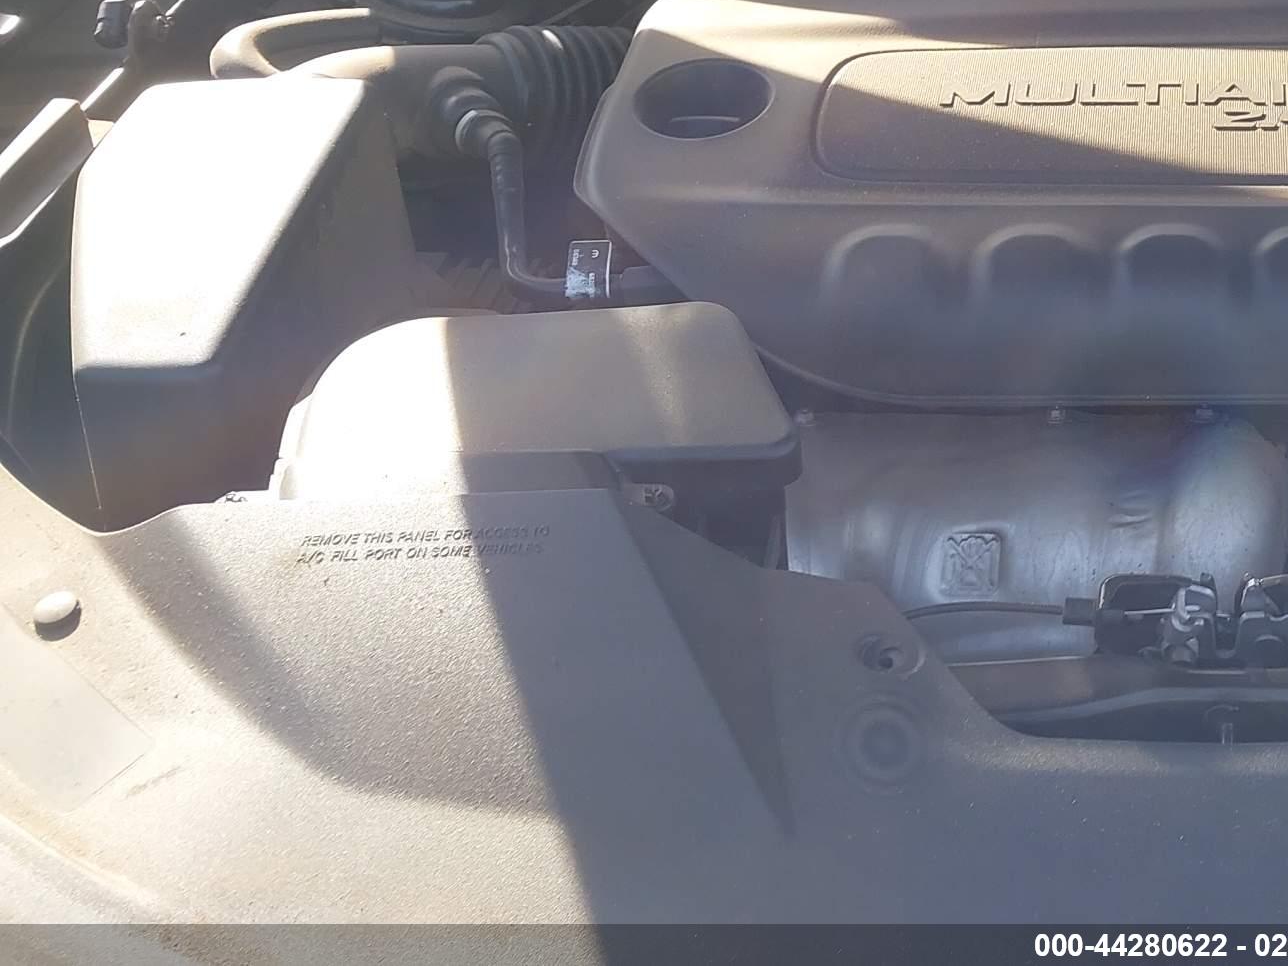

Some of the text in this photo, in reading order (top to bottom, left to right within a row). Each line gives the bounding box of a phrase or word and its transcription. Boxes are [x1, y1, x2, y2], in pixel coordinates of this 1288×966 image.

[300, 533, 361, 546] REMOVE
[364, 532, 394, 544] THIS
[396, 530, 440, 543] PANEL
[444, 529, 473, 541] FOR
[296, 550, 325, 564] A/C
[330, 549, 358, 562] FILL
[364, 548, 403, 560] PORT
[406, 546, 428, 559] ON
[431, 545, 473, 557] SOME
